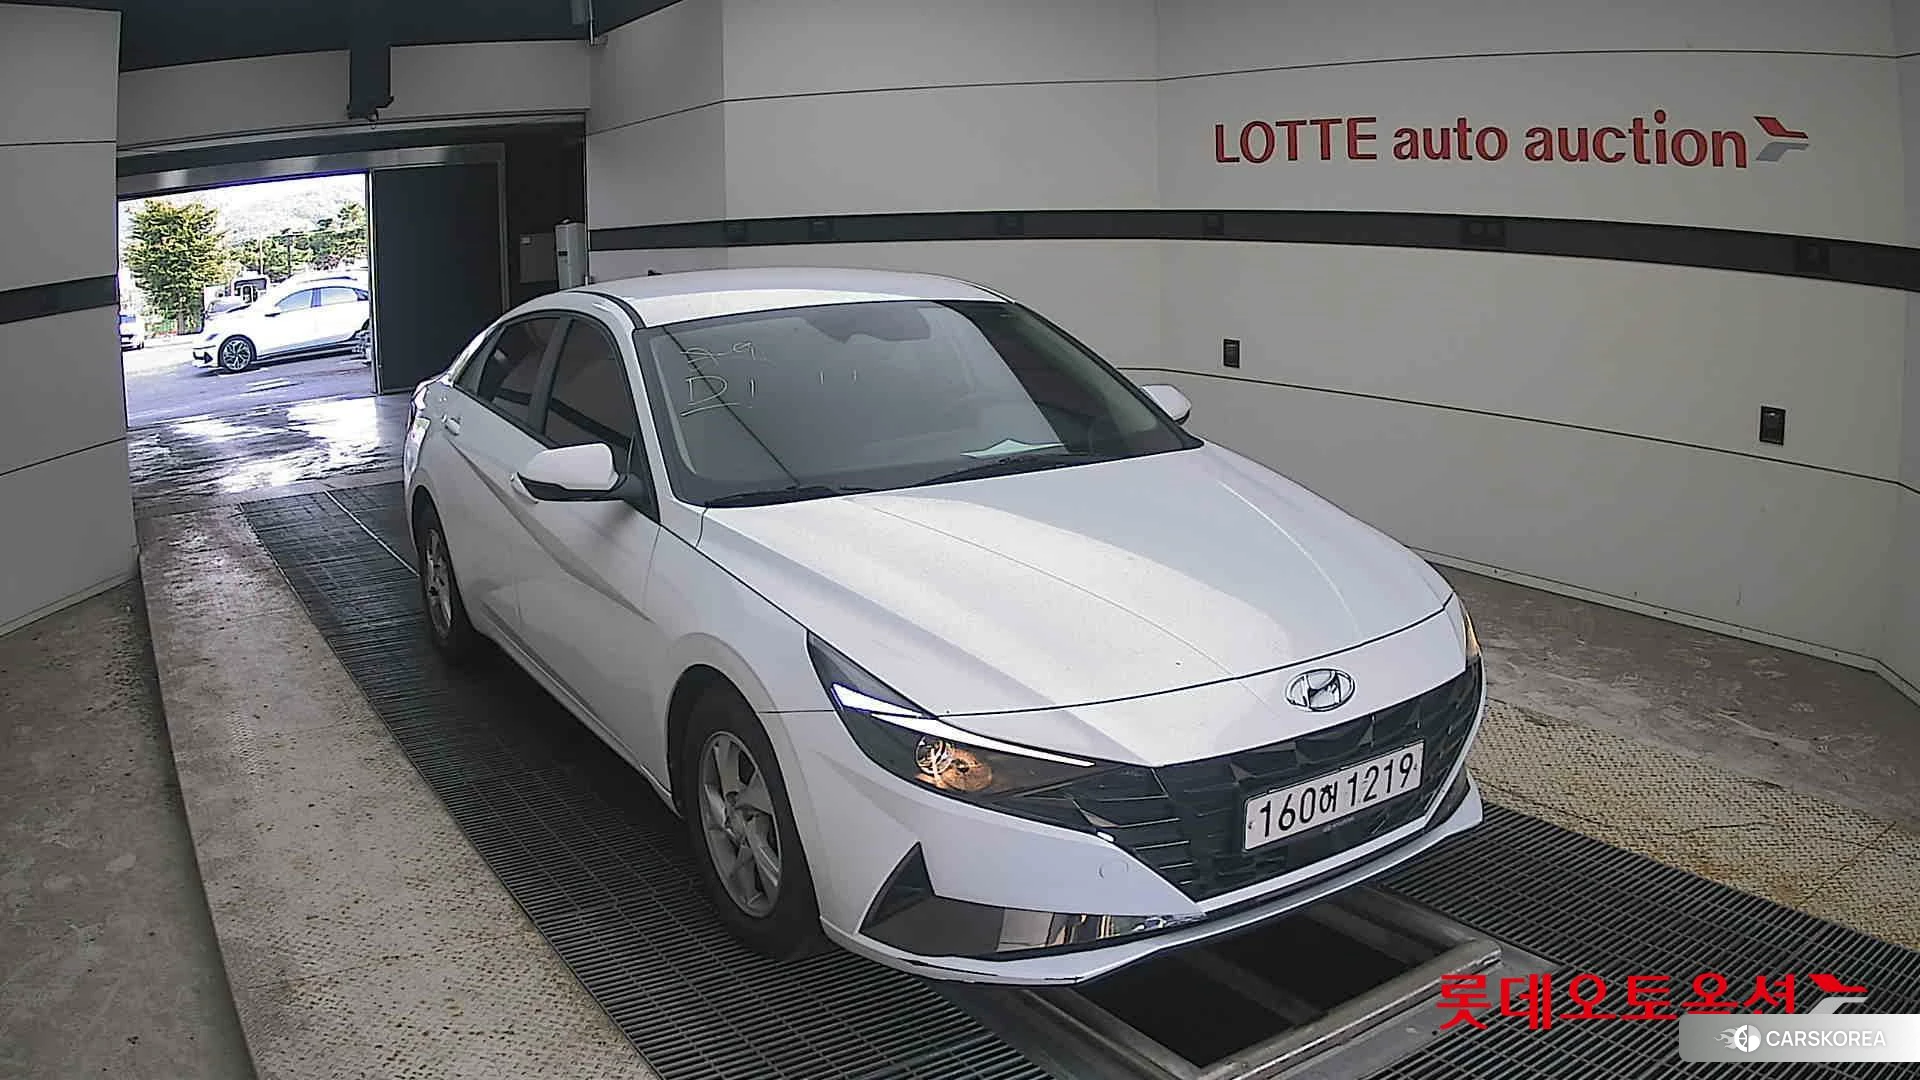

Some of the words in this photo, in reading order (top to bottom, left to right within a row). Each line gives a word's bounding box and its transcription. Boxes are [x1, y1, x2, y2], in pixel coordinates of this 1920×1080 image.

[1214, 115, 1378, 164] LOTTE
[1393, 116, 1508, 162] auto
[1524, 109, 1748, 169] auction
[1259, 781, 1338, 838] 160허
[1347, 752, 1414, 807] 1219
